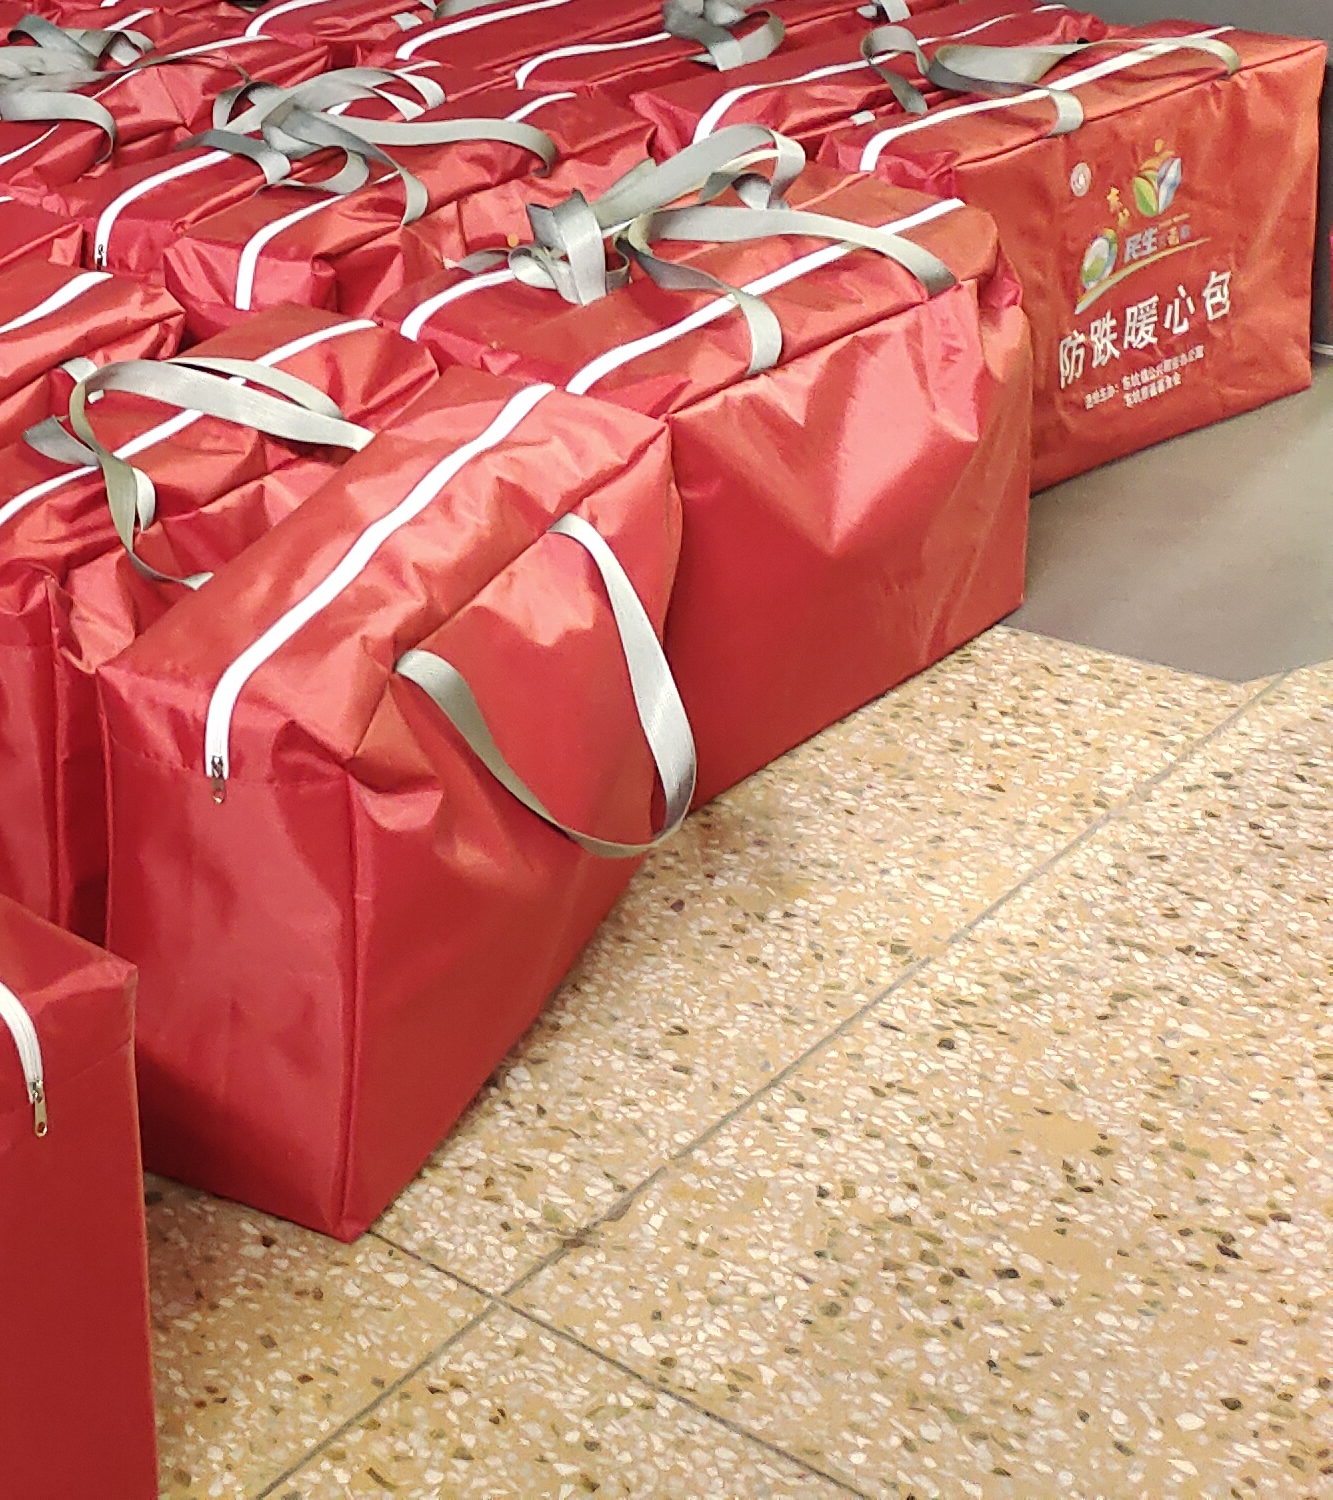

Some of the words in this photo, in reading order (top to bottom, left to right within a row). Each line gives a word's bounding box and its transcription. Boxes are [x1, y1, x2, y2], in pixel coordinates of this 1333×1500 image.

[1058, 271, 1232, 390] 防跌暖心包
